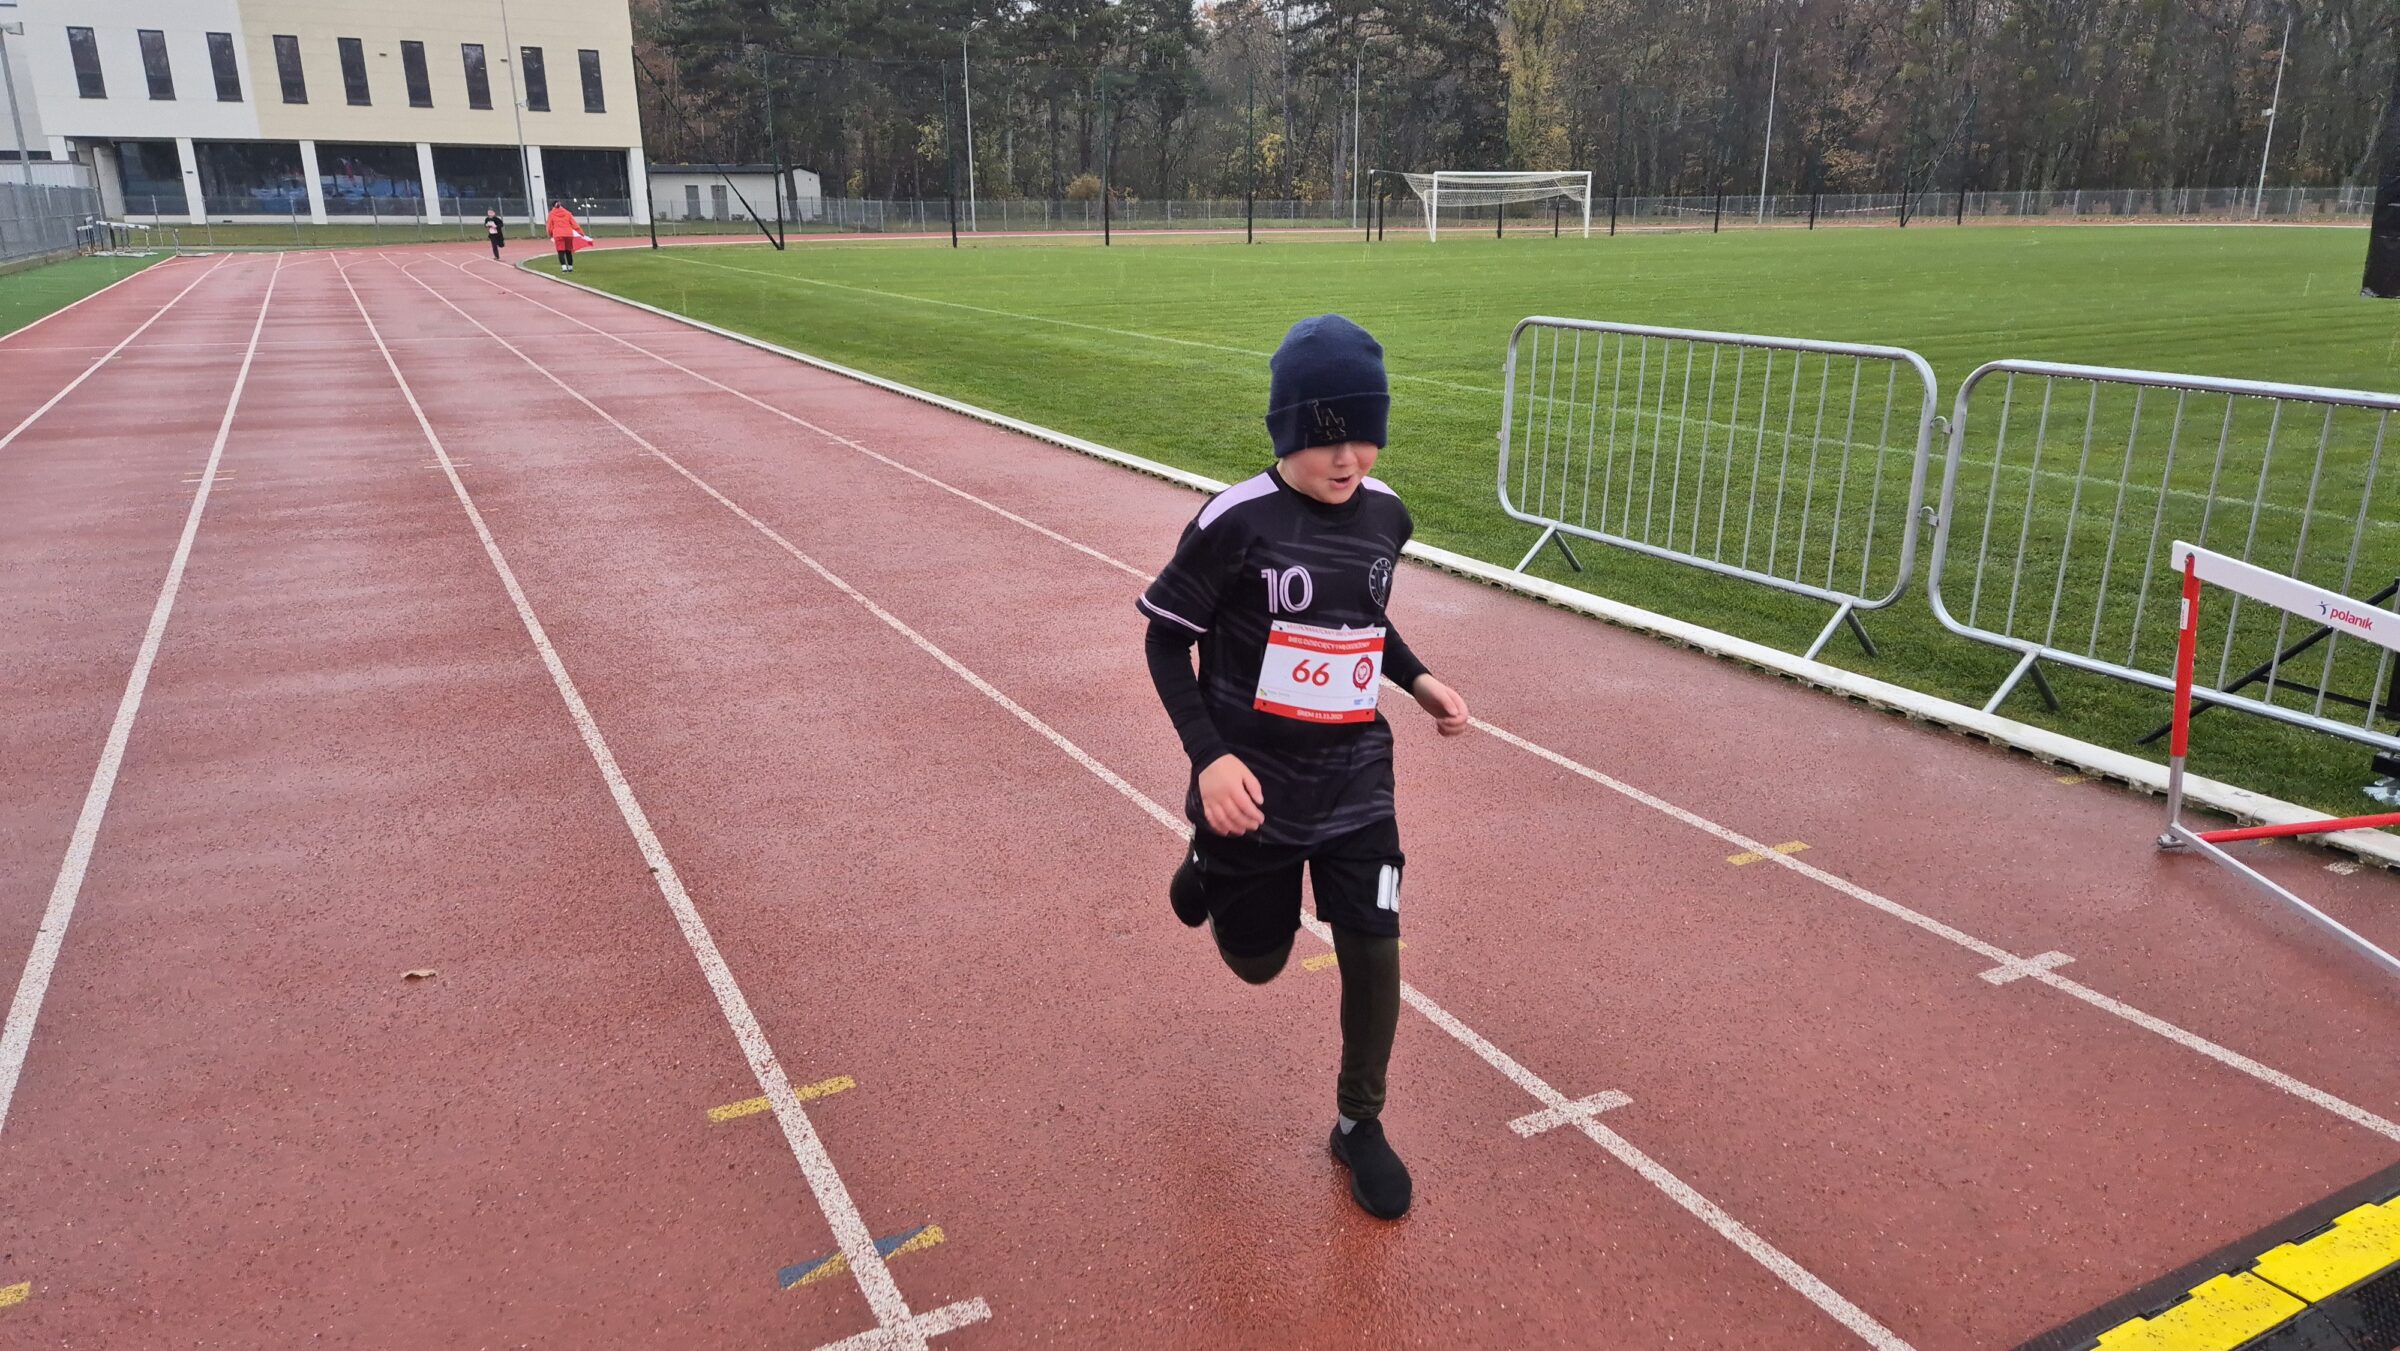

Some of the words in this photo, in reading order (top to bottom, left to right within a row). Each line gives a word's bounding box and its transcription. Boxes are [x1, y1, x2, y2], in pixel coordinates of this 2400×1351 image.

[1261, 565, 1313, 614] 10
[2330, 608, 2374, 631] polanik
[1292, 659, 1330, 687] 66
